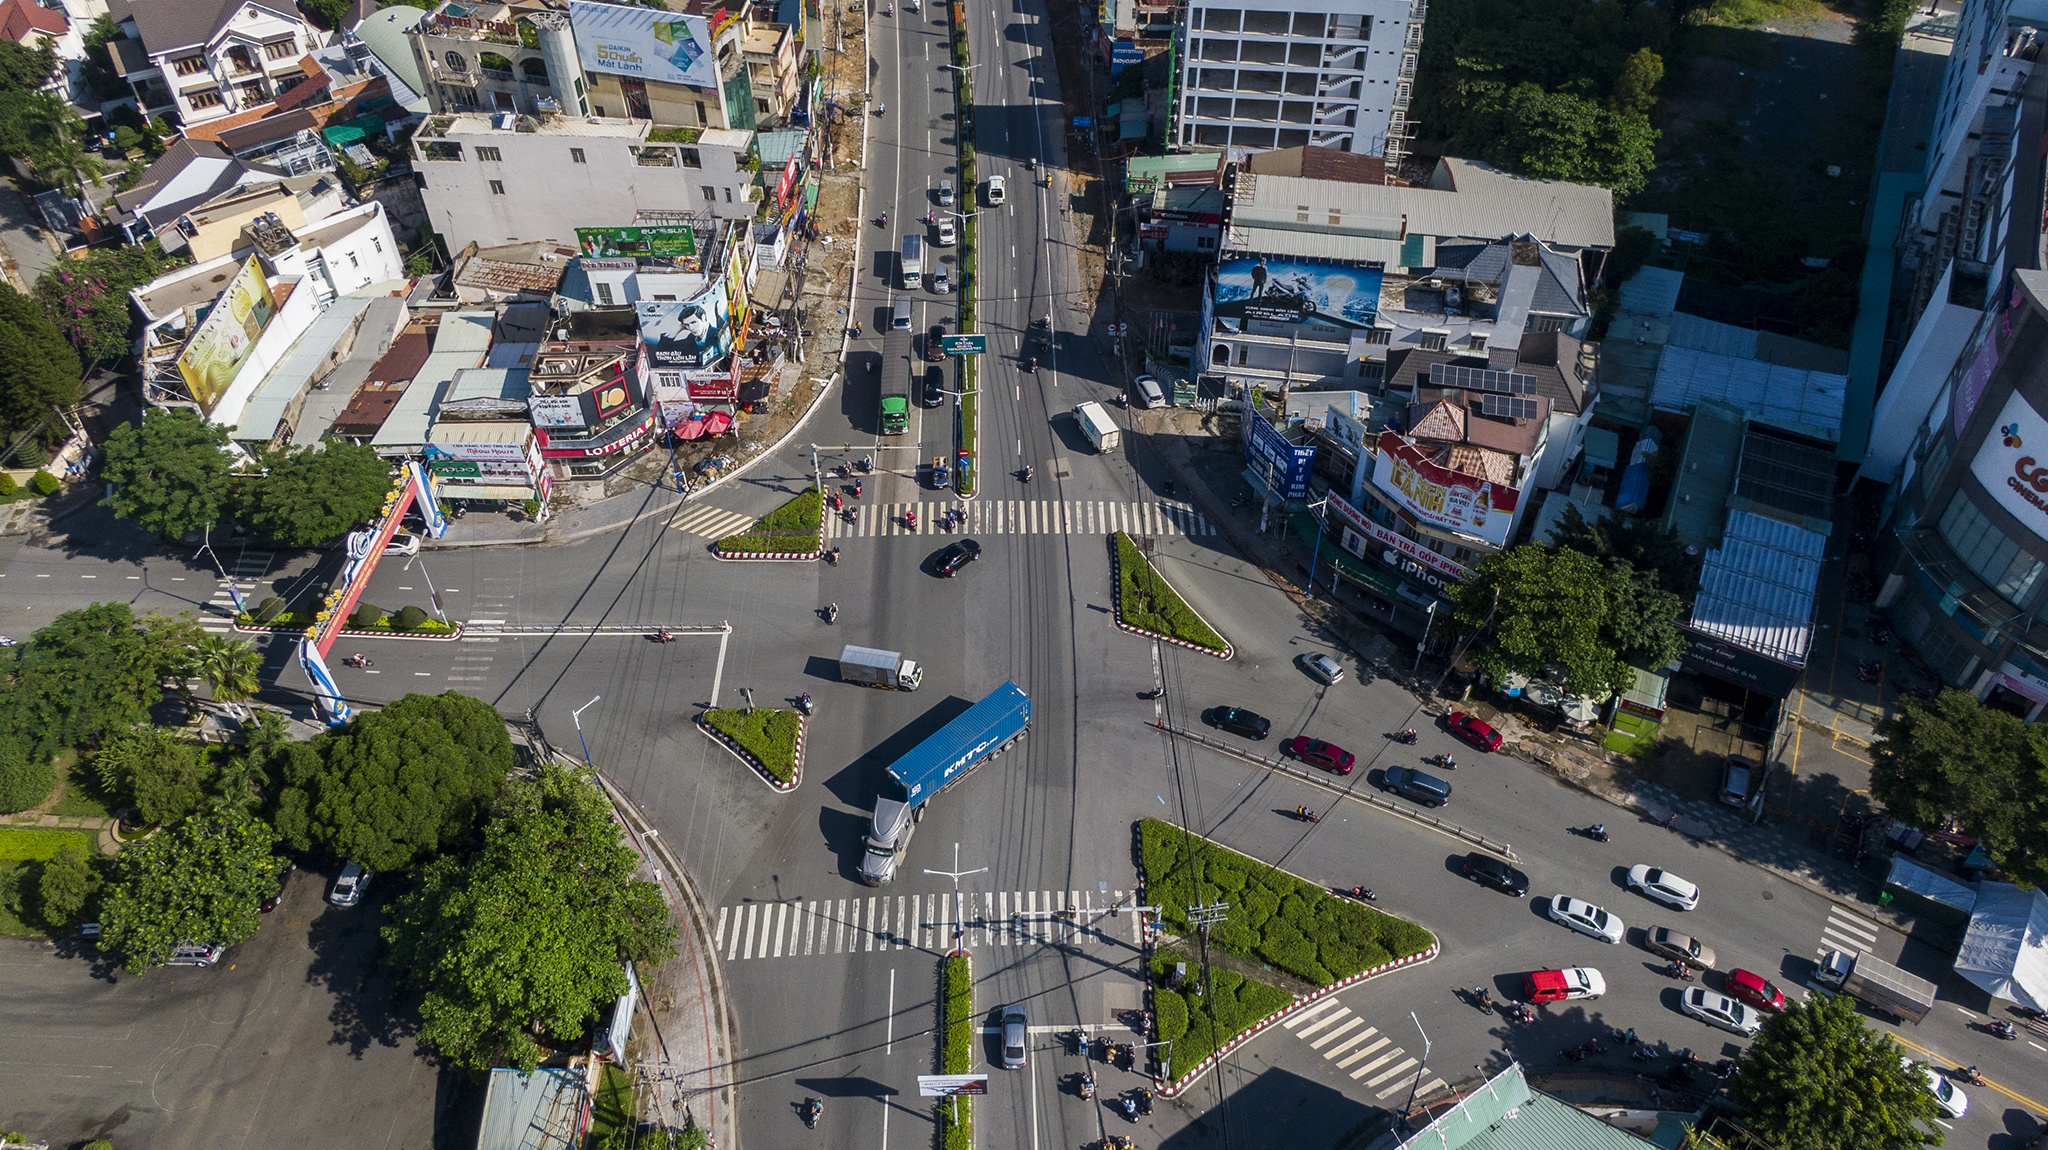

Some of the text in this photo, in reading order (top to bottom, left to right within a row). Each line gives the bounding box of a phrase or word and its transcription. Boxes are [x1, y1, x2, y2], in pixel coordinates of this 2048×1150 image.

[597, 44, 643, 64] 5 Chuẩn
[597, 59, 643, 71] Mát Lành
[1160, 212, 1188, 220] YOKOHAMA
[585, 427, 645, 456] LOTTERIA
[1294, 448, 1314, 457] THIẾT
[2014, 456, 2048, 493] CG
[1287, 490, 1306, 498] PHÁT
[1328, 491, 1343, 506] ĐÔNG
[1343, 503, 1361, 522] DƯƠNG
[2007, 476, 2048, 515] CINEMA
[1376, 527, 1396, 545] BÁN
[1398, 538, 1416, 555] TRẢ
[1418, 548, 1438, 564] GÓP
[1400, 558, 1448, 591] iphon
